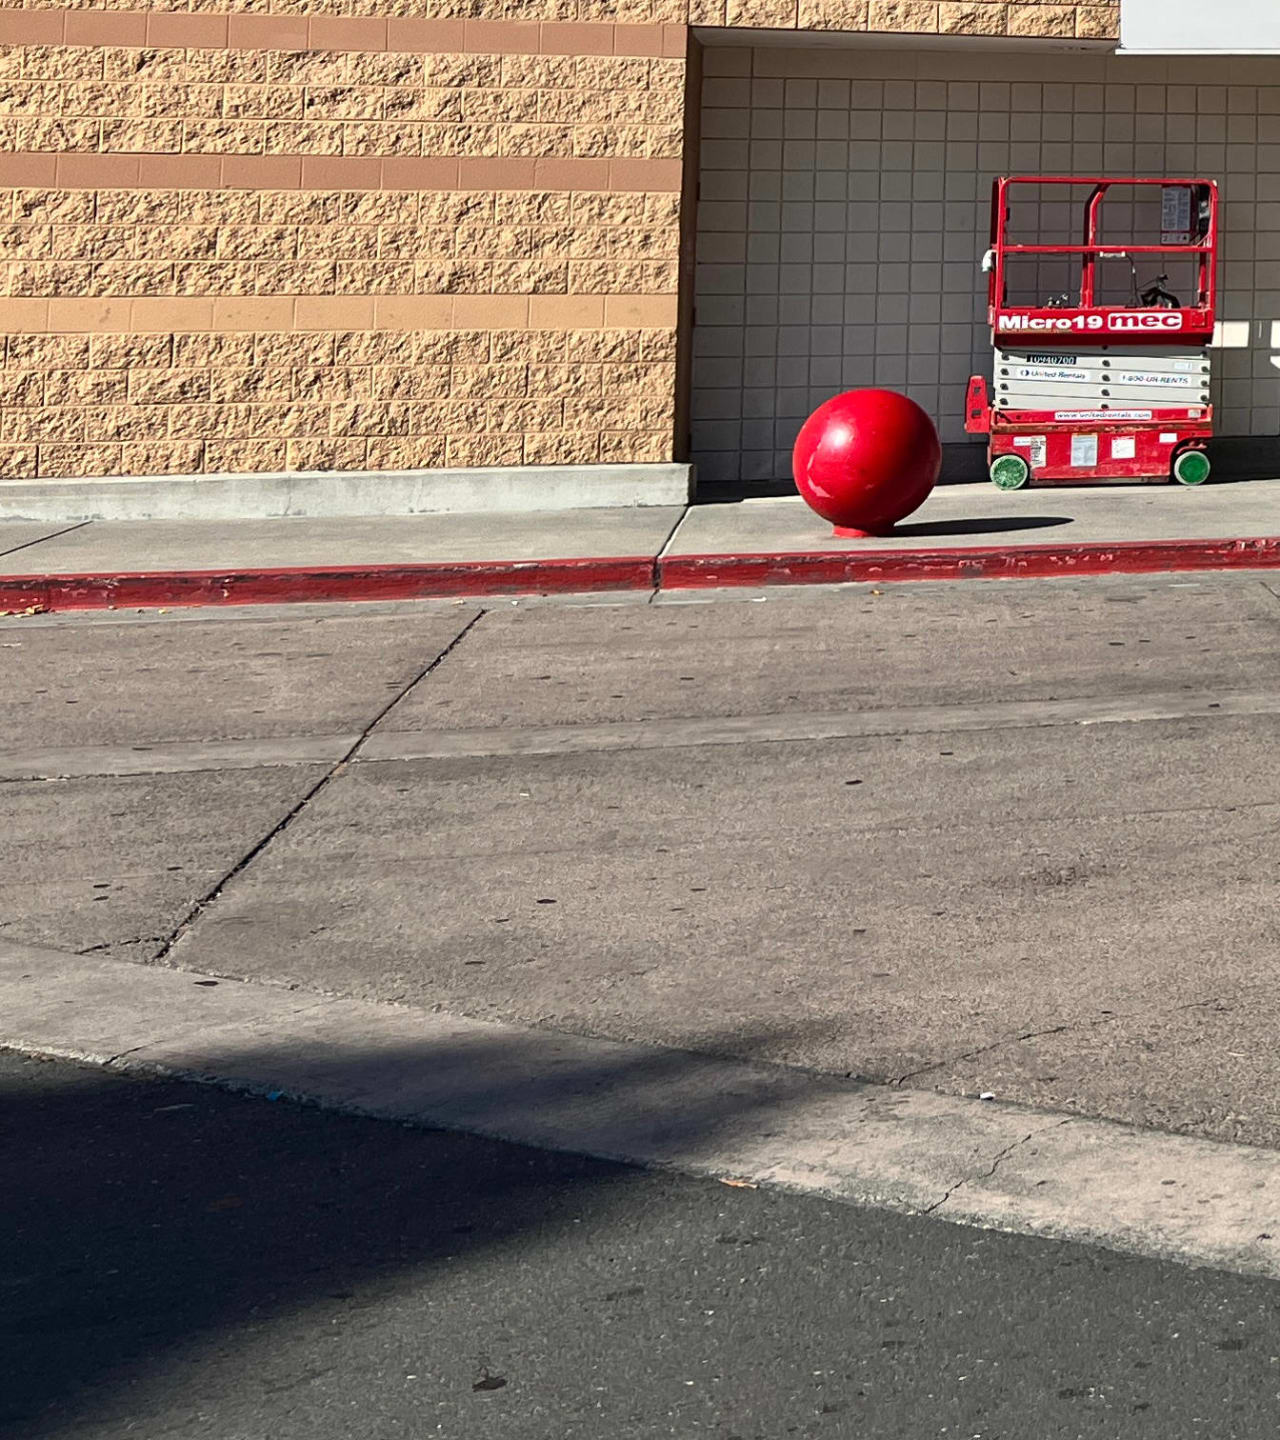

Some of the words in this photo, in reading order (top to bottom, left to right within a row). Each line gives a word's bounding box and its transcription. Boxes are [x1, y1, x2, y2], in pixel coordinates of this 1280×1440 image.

[998, 314, 1104, 330] Micro19
[1110, 314, 1181, 328] mec
[1031, 369, 1057, 378] United
[1058, 370, 1086, 379] Rentals
